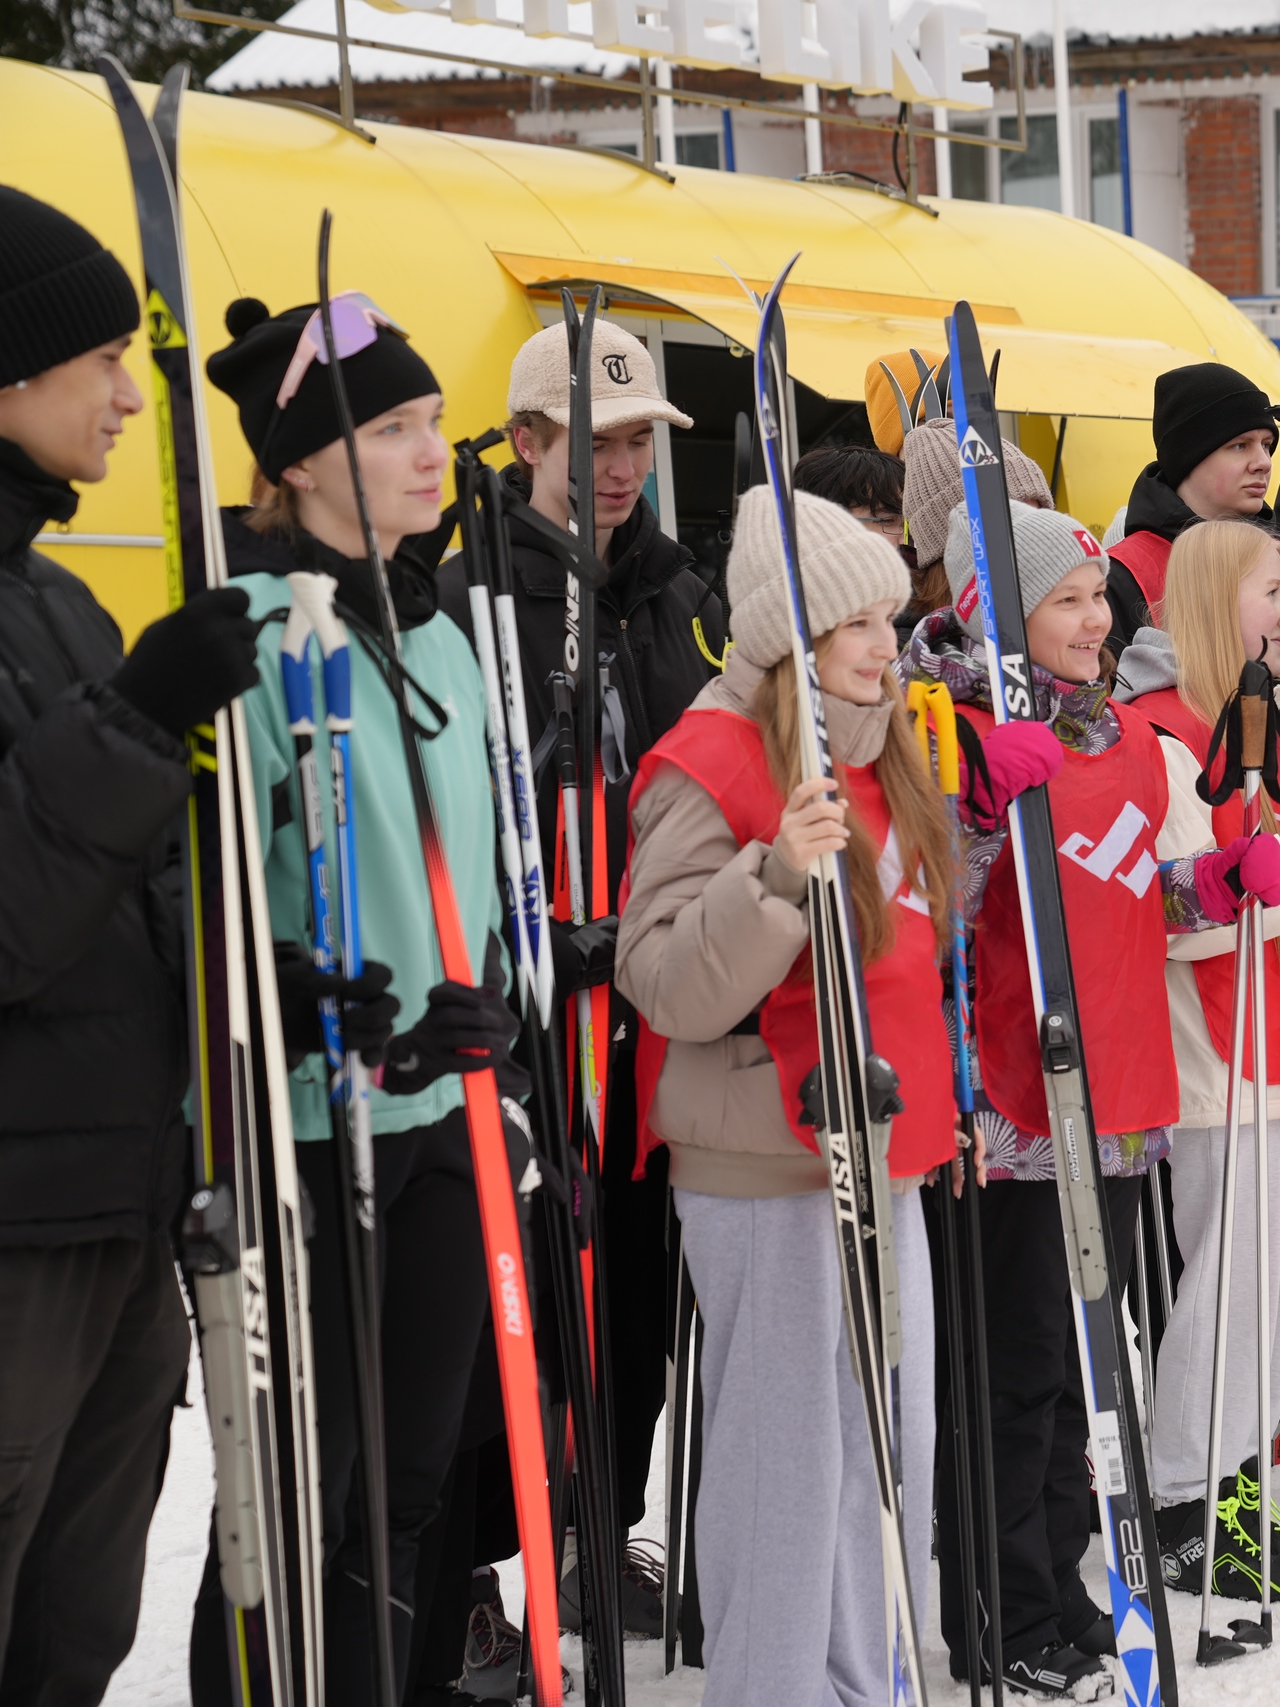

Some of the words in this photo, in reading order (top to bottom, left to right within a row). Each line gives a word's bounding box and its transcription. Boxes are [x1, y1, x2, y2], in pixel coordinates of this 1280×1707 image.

[970, 518, 984, 560] WAX
[977, 571, 995, 636] SPORT
[1000, 653, 1031, 719] SA
[829, 1132, 856, 1227] TISA
[241, 1246, 272, 1400] TISA
[1119, 1517, 1148, 1603] 182
